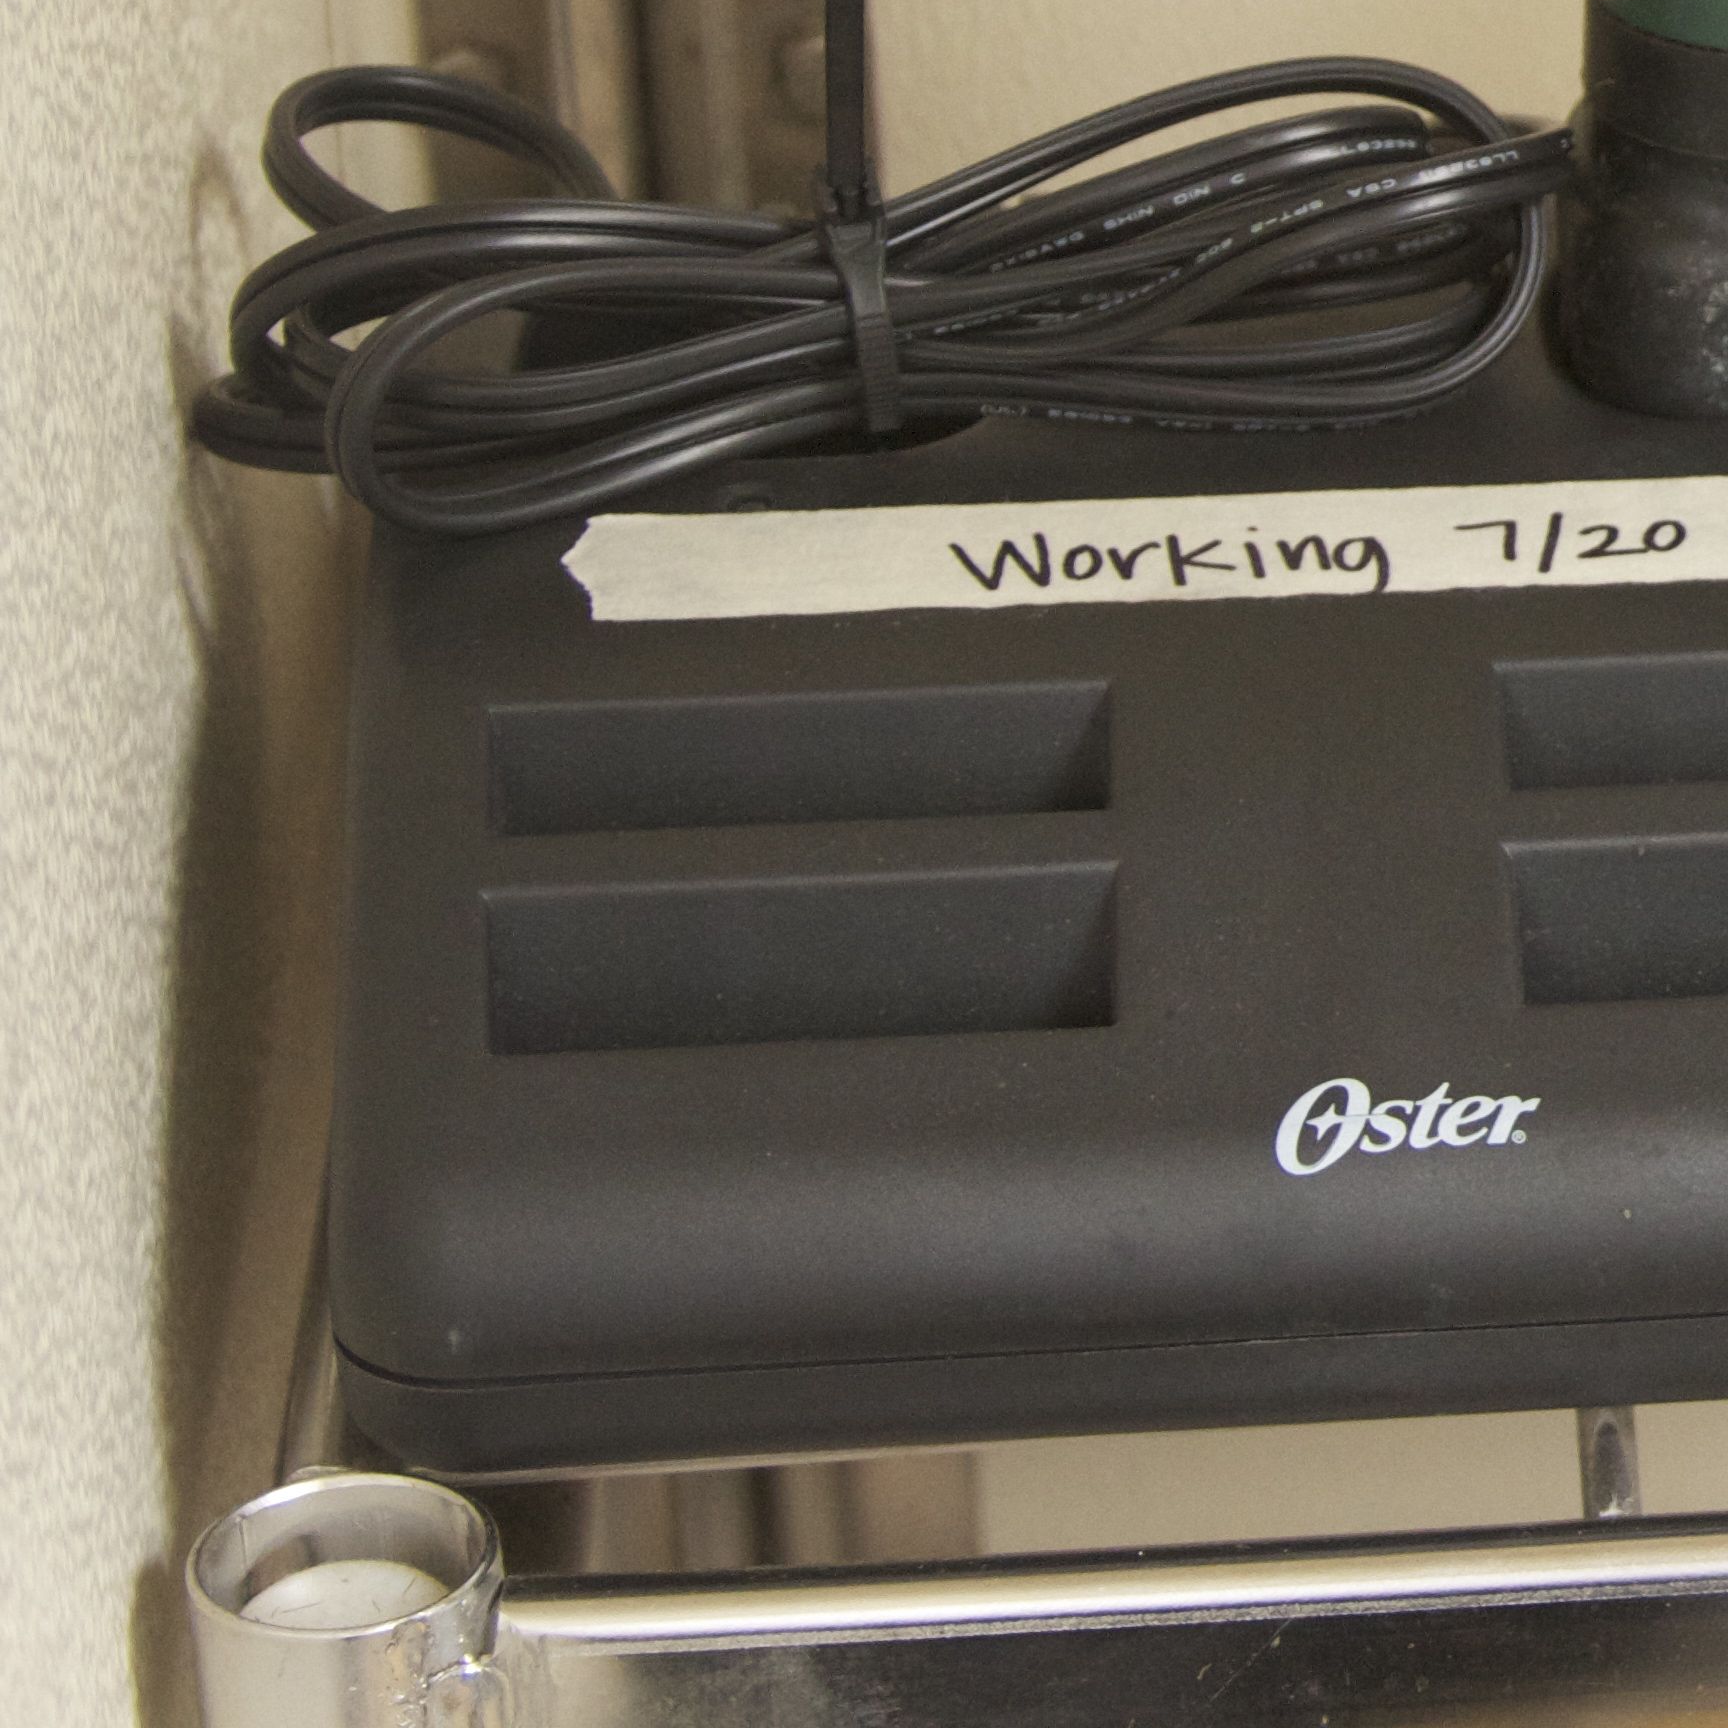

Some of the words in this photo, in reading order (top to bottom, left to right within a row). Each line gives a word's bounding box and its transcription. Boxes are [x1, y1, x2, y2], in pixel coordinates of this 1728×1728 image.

[949, 525, 1392, 594] Working
[1454, 512, 1687, 574] 7/20
[1275, 1077, 1542, 1175] Oster
